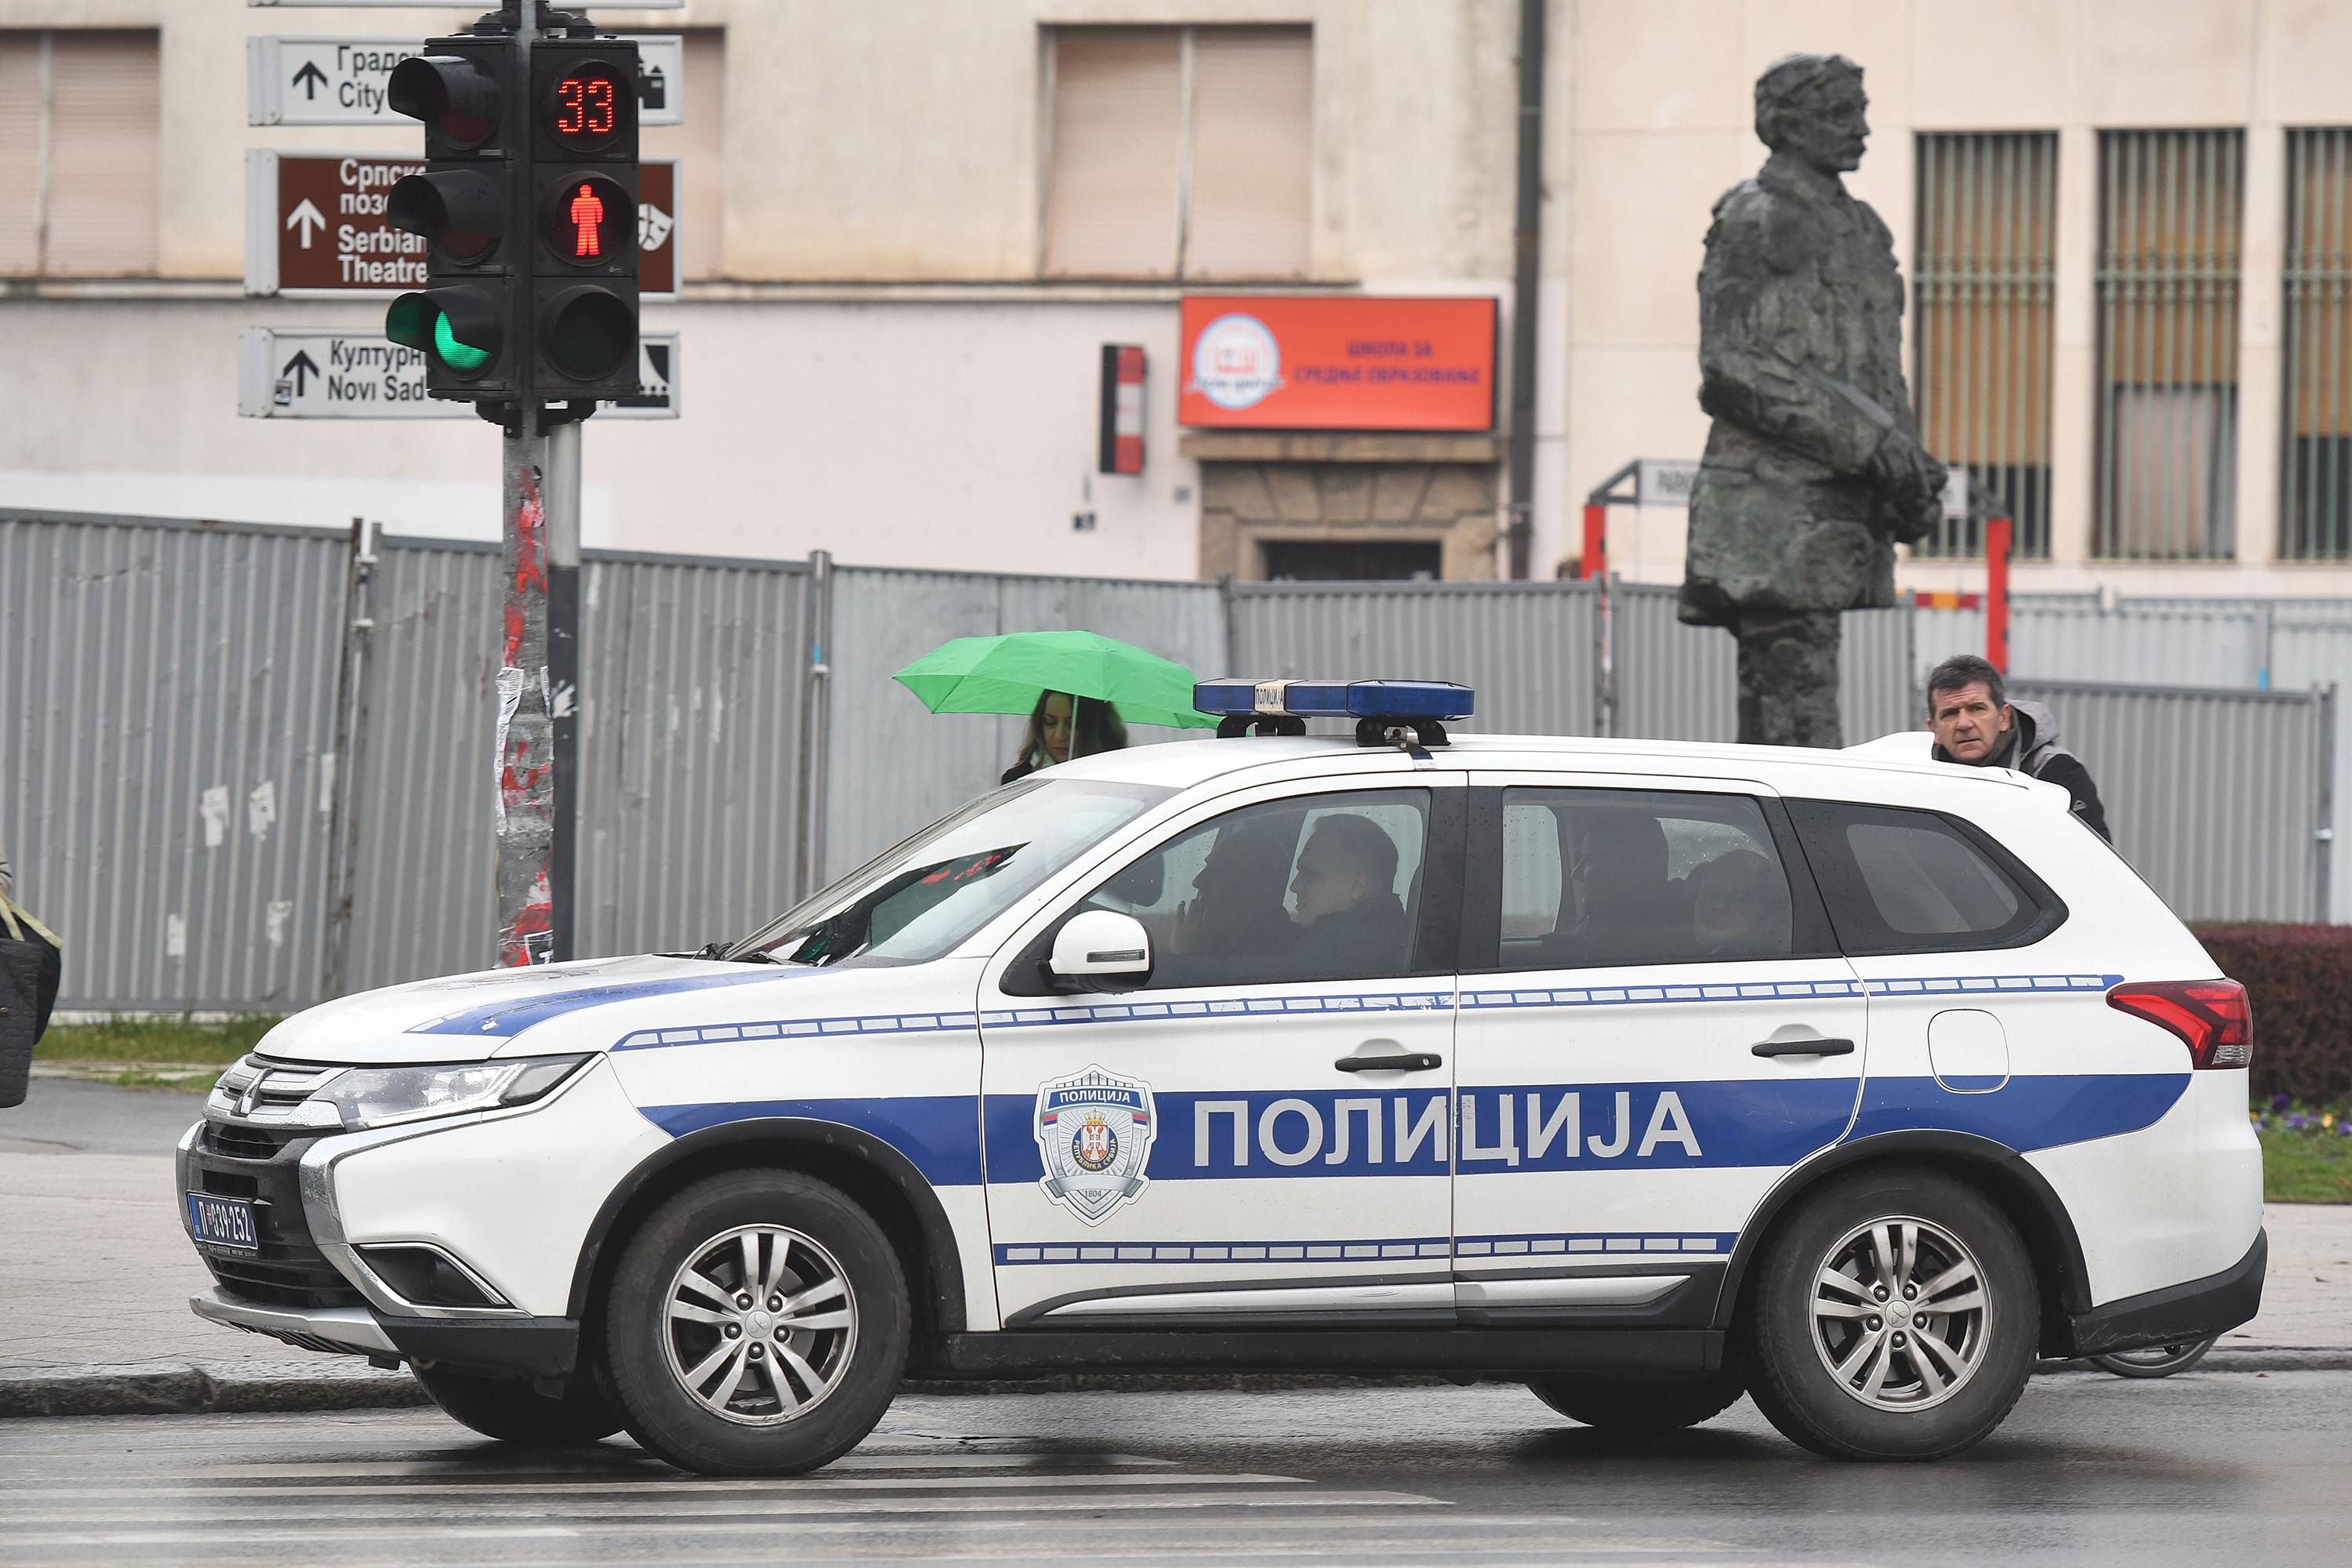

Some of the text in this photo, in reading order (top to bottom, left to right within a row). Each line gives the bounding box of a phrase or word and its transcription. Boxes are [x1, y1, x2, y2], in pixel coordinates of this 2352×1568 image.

[337, 45, 423, 77] Град
[339, 81, 384, 114] City
[558, 80, 613, 132] 33
[337, 254, 427, 283] Theatre
[328, 375, 424, 401] Novi Sad
[1059, 1090, 1131, 1104] ПОЛИЦИЈА
[1194, 1091, 1703, 1167] ПОЛИЦИЈА
[1073, 1138, 1116, 1170] РЕПУБЛИКА СРБИЈА
